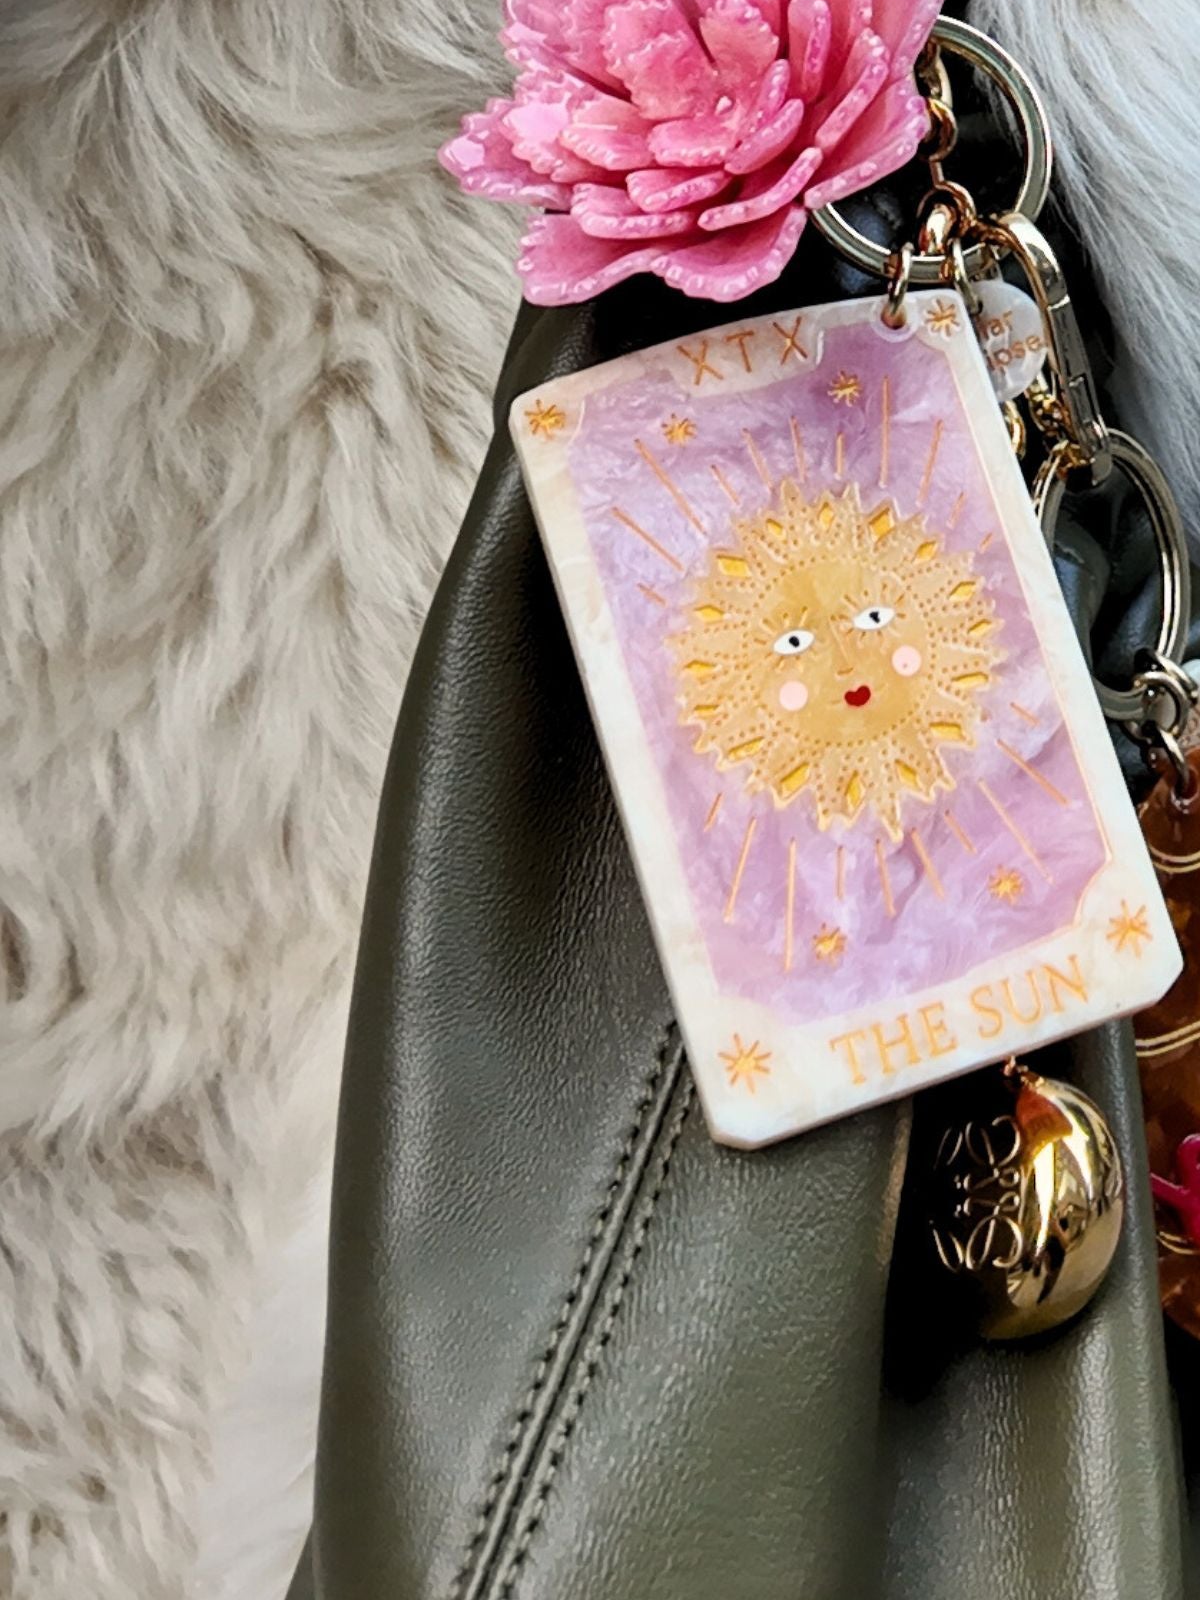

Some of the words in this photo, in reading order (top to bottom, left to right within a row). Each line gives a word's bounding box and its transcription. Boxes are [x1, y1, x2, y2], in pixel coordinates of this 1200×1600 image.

[974, 310, 1013, 340] lar
[983, 335, 1041, 375] ipse
[829, 1001, 959, 1085] THE
[969, 954, 1089, 1040] SUN
